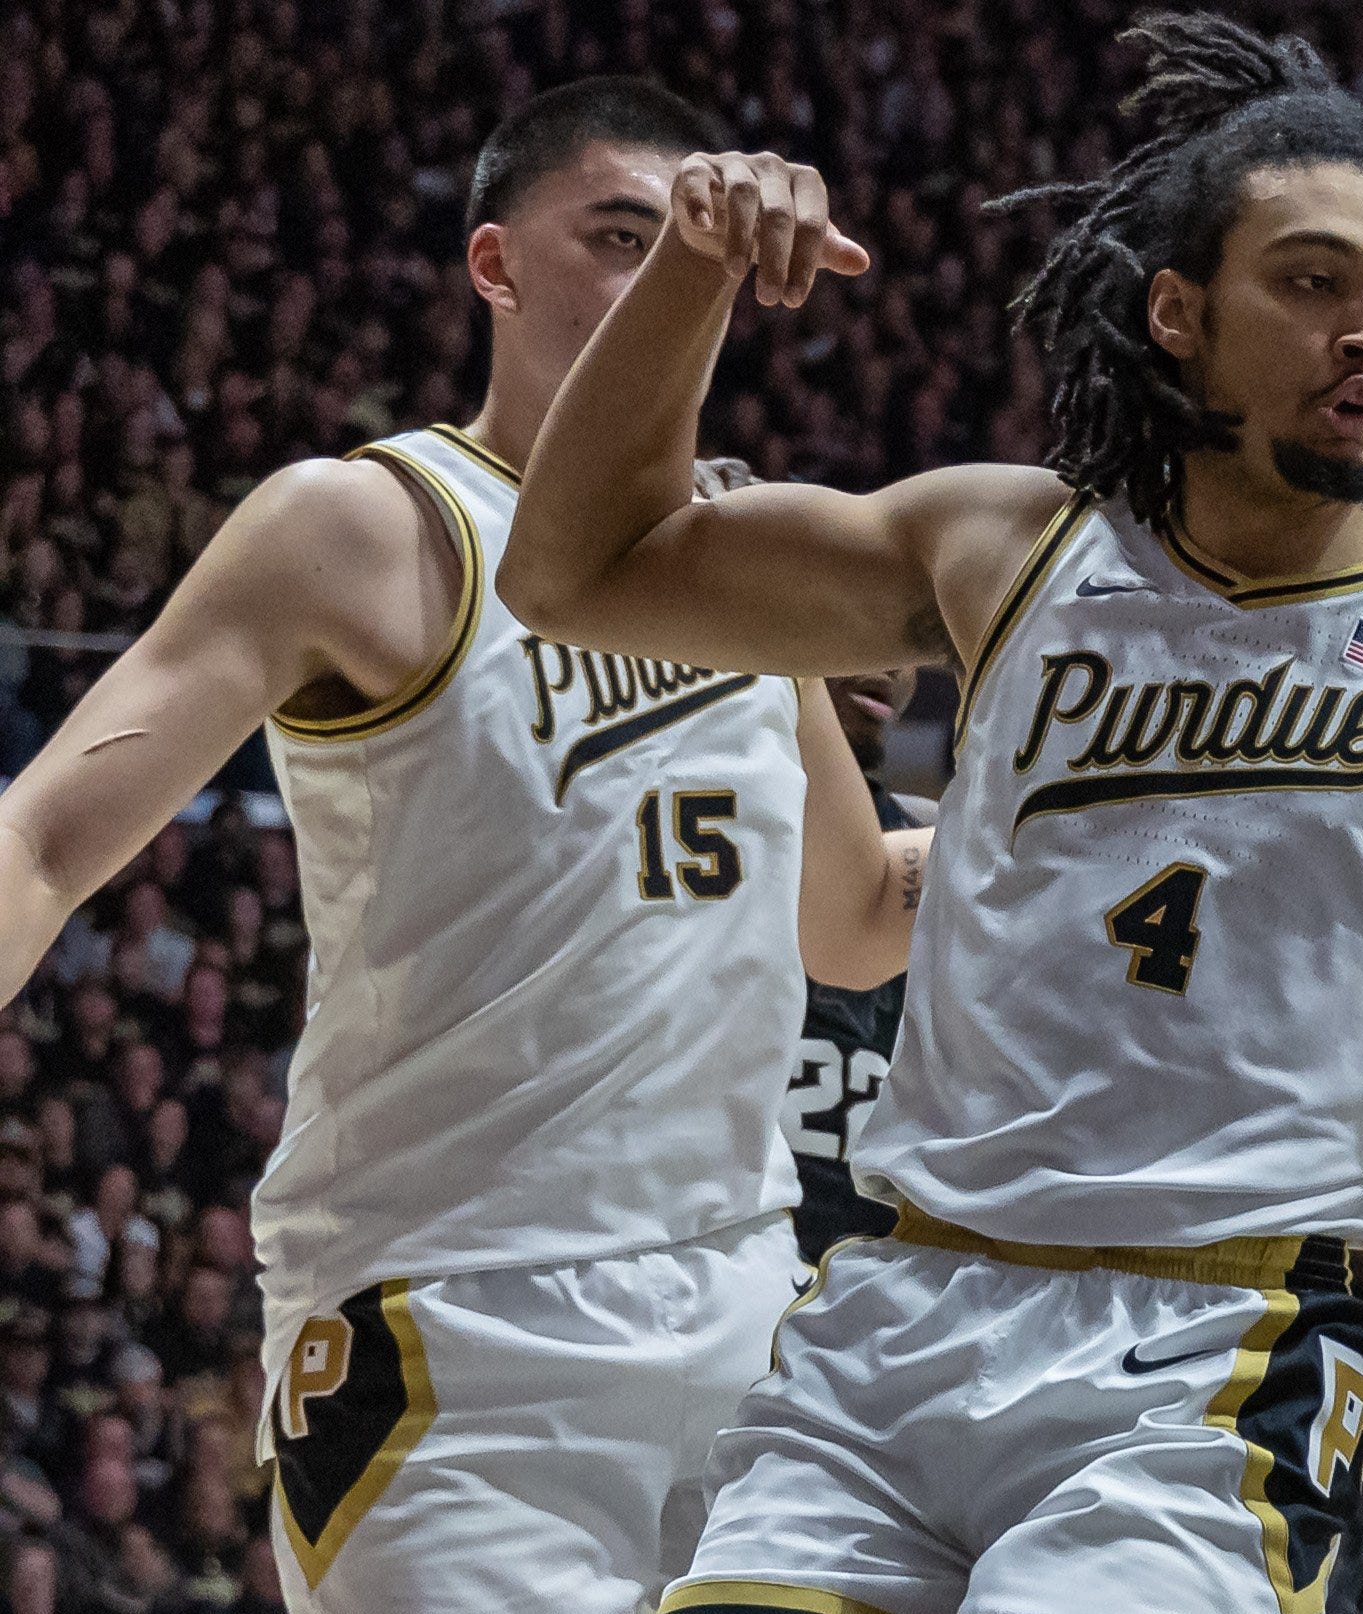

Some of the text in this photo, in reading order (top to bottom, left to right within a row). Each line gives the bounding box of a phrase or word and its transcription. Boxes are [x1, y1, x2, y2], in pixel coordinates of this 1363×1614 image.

[636, 788, 743, 902] 15
[1103, 861, 1209, 998] 4
[279, 1313, 355, 1441] P
